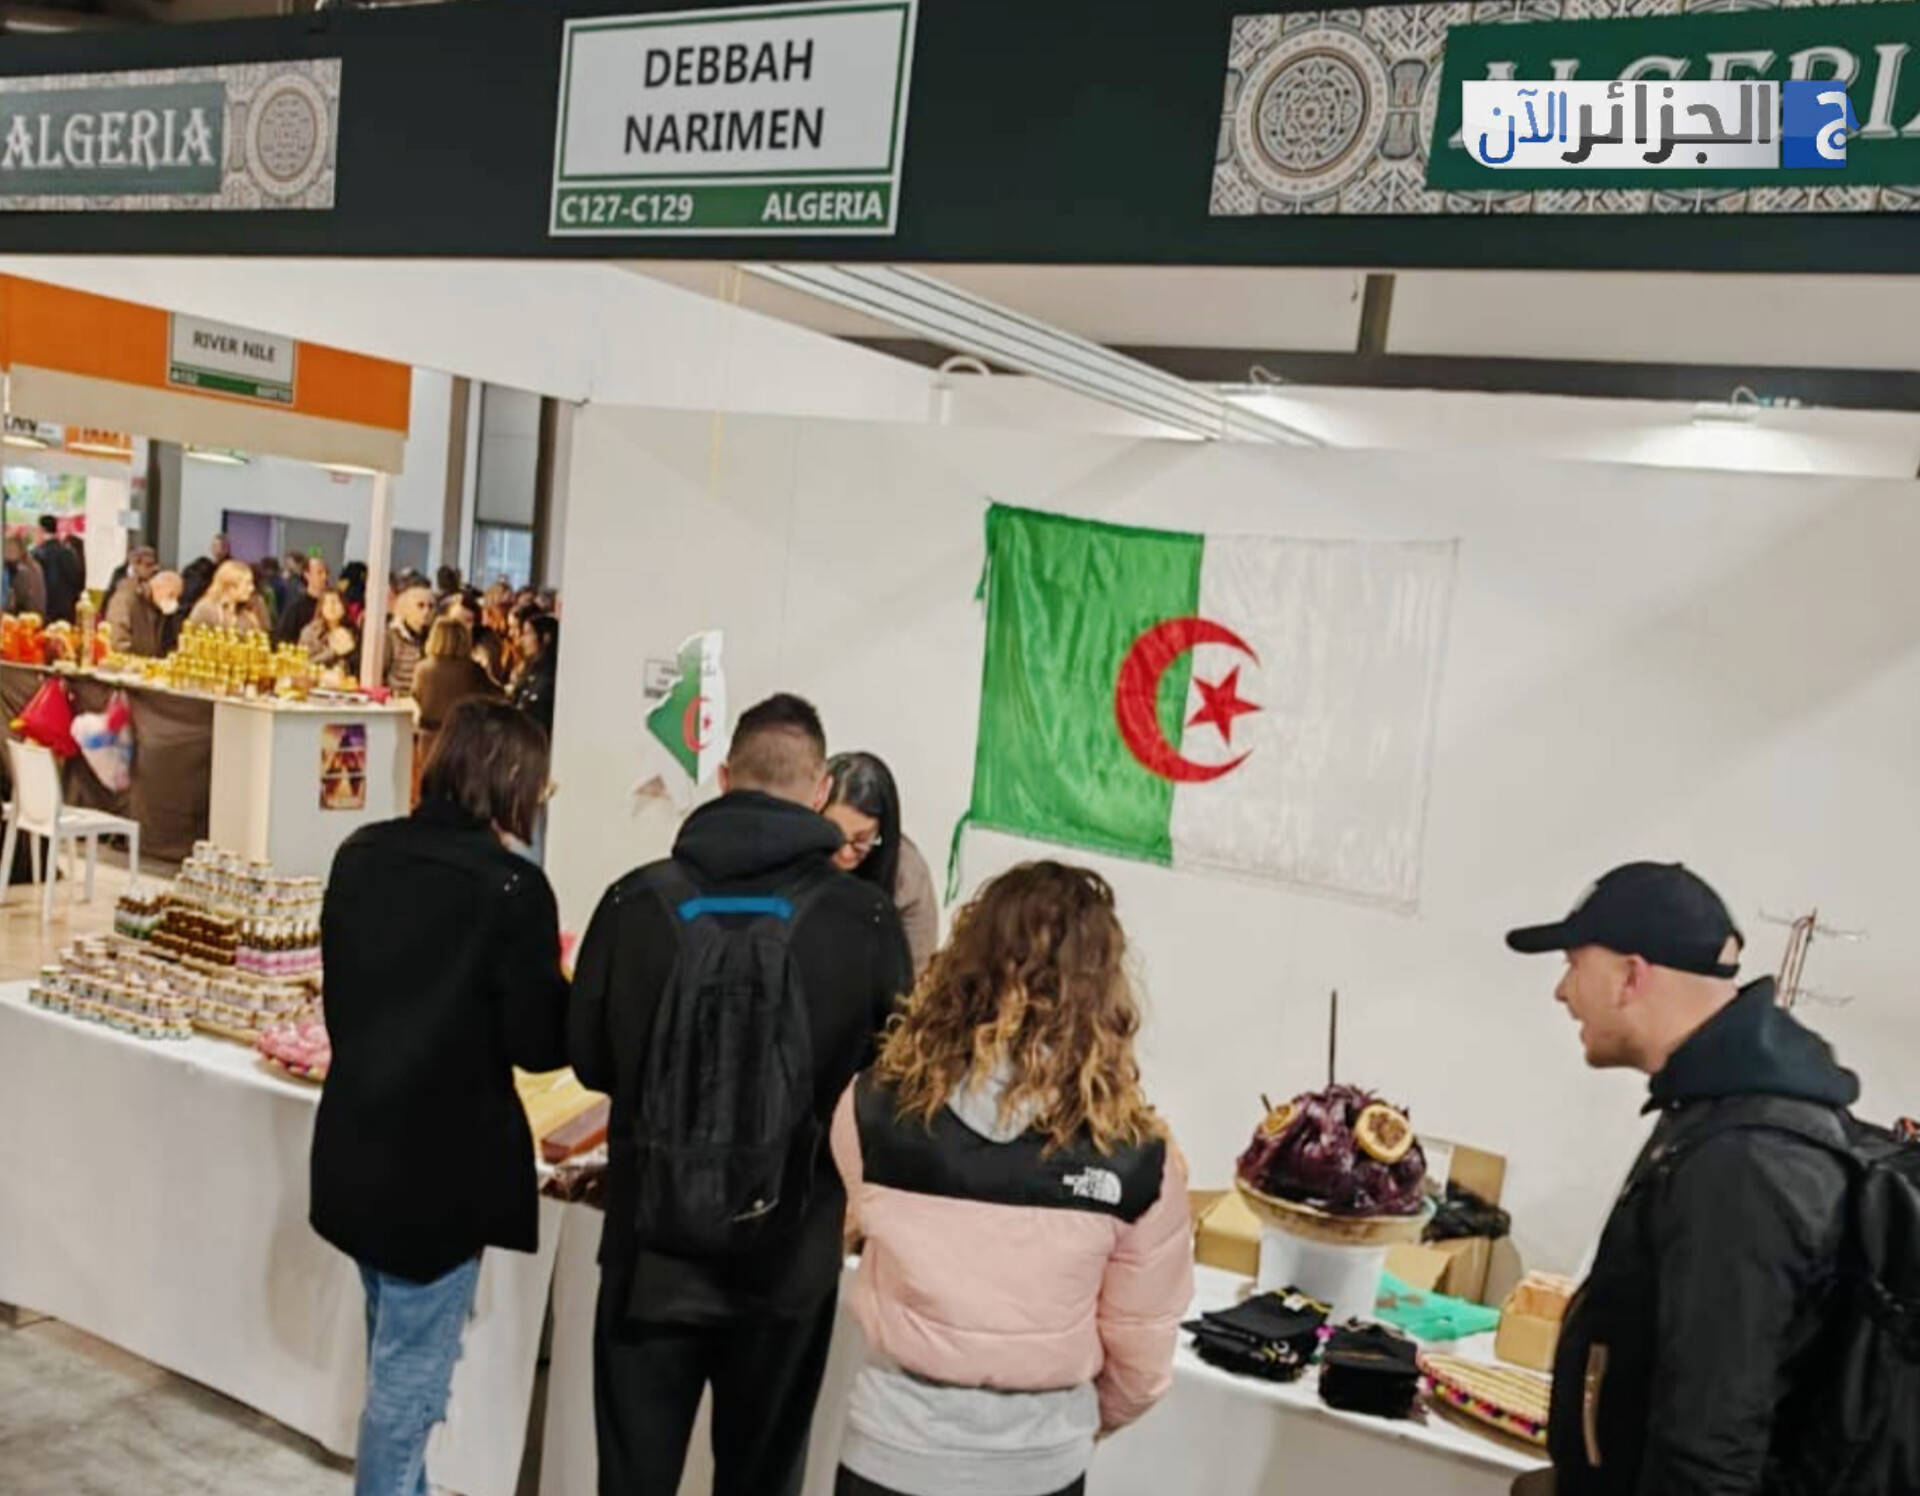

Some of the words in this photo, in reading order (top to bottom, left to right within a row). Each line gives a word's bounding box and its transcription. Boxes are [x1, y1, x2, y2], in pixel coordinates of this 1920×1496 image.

[643, 38, 814, 88] DEBBAH
[1, 108, 216, 172] ALGERIA
[624, 107, 824, 154] NARIMEN
[560, 194, 694, 222] C127-C129
[762, 191, 883, 221] ALGERIA
[193, 330, 238, 355] RIVER
[243, 341, 276, 363] NILE
